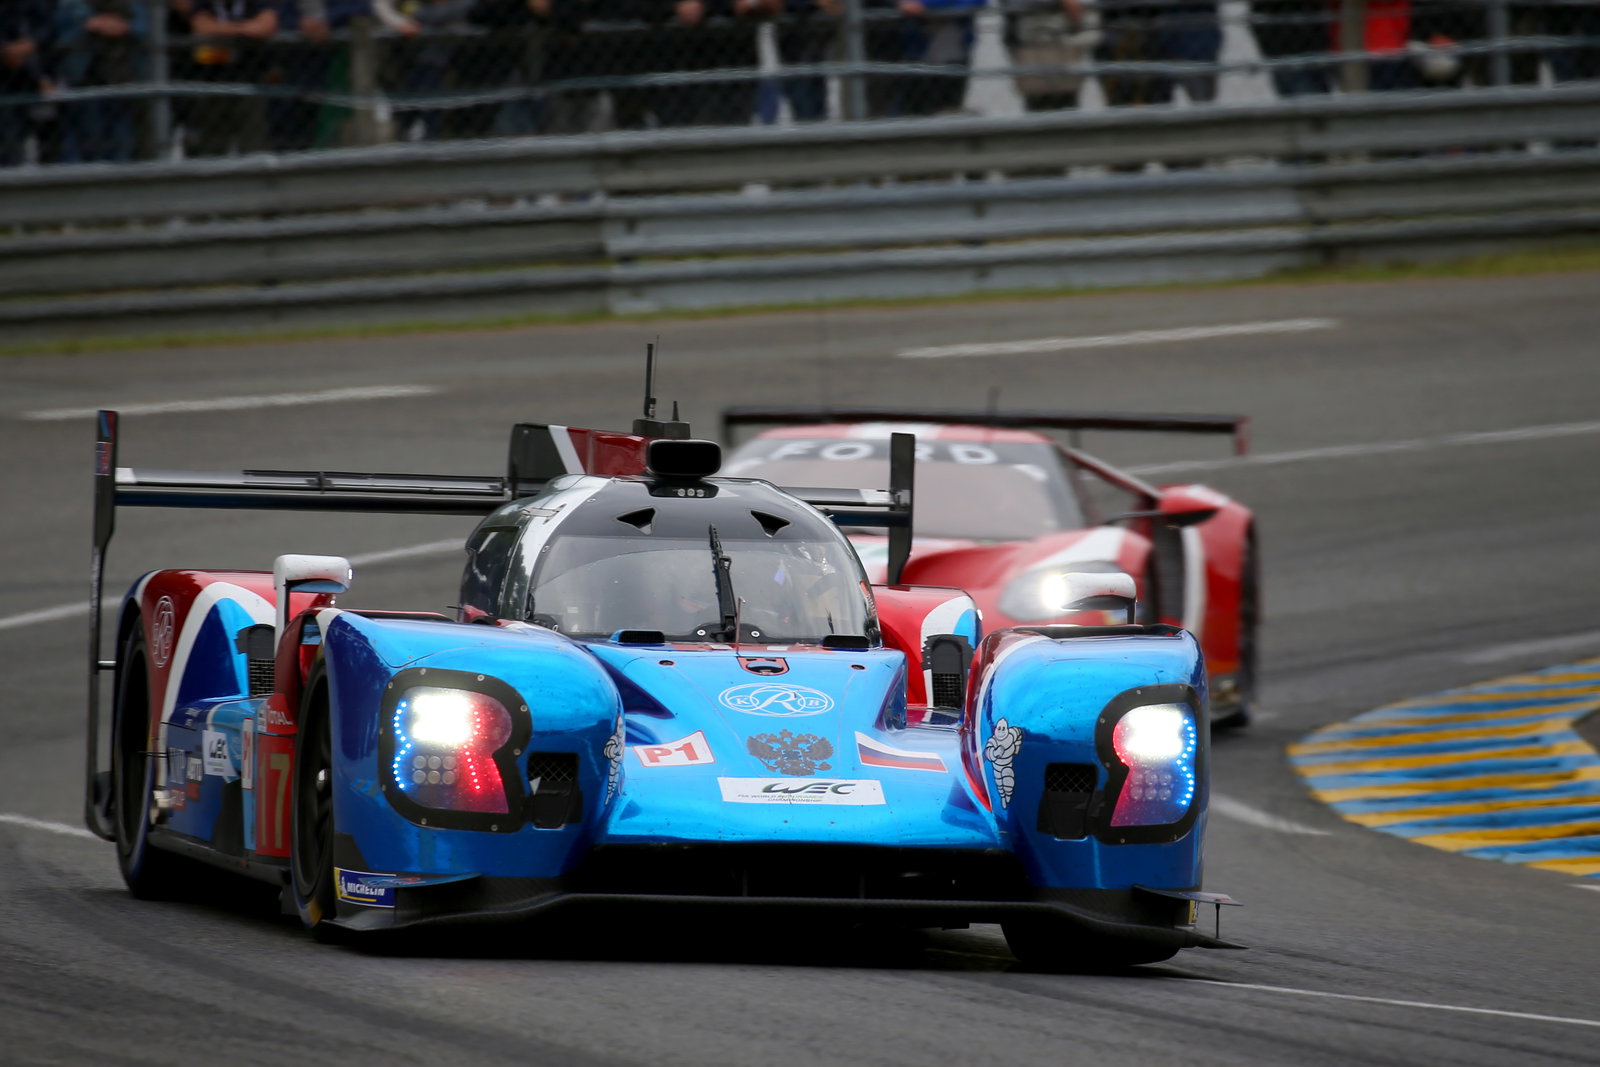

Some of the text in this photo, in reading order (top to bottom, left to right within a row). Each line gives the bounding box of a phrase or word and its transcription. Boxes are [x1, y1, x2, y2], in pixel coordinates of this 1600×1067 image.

[643, 742, 700, 762] P1
[761, 782, 856, 795] WEC
[258, 751, 291, 849] 17
